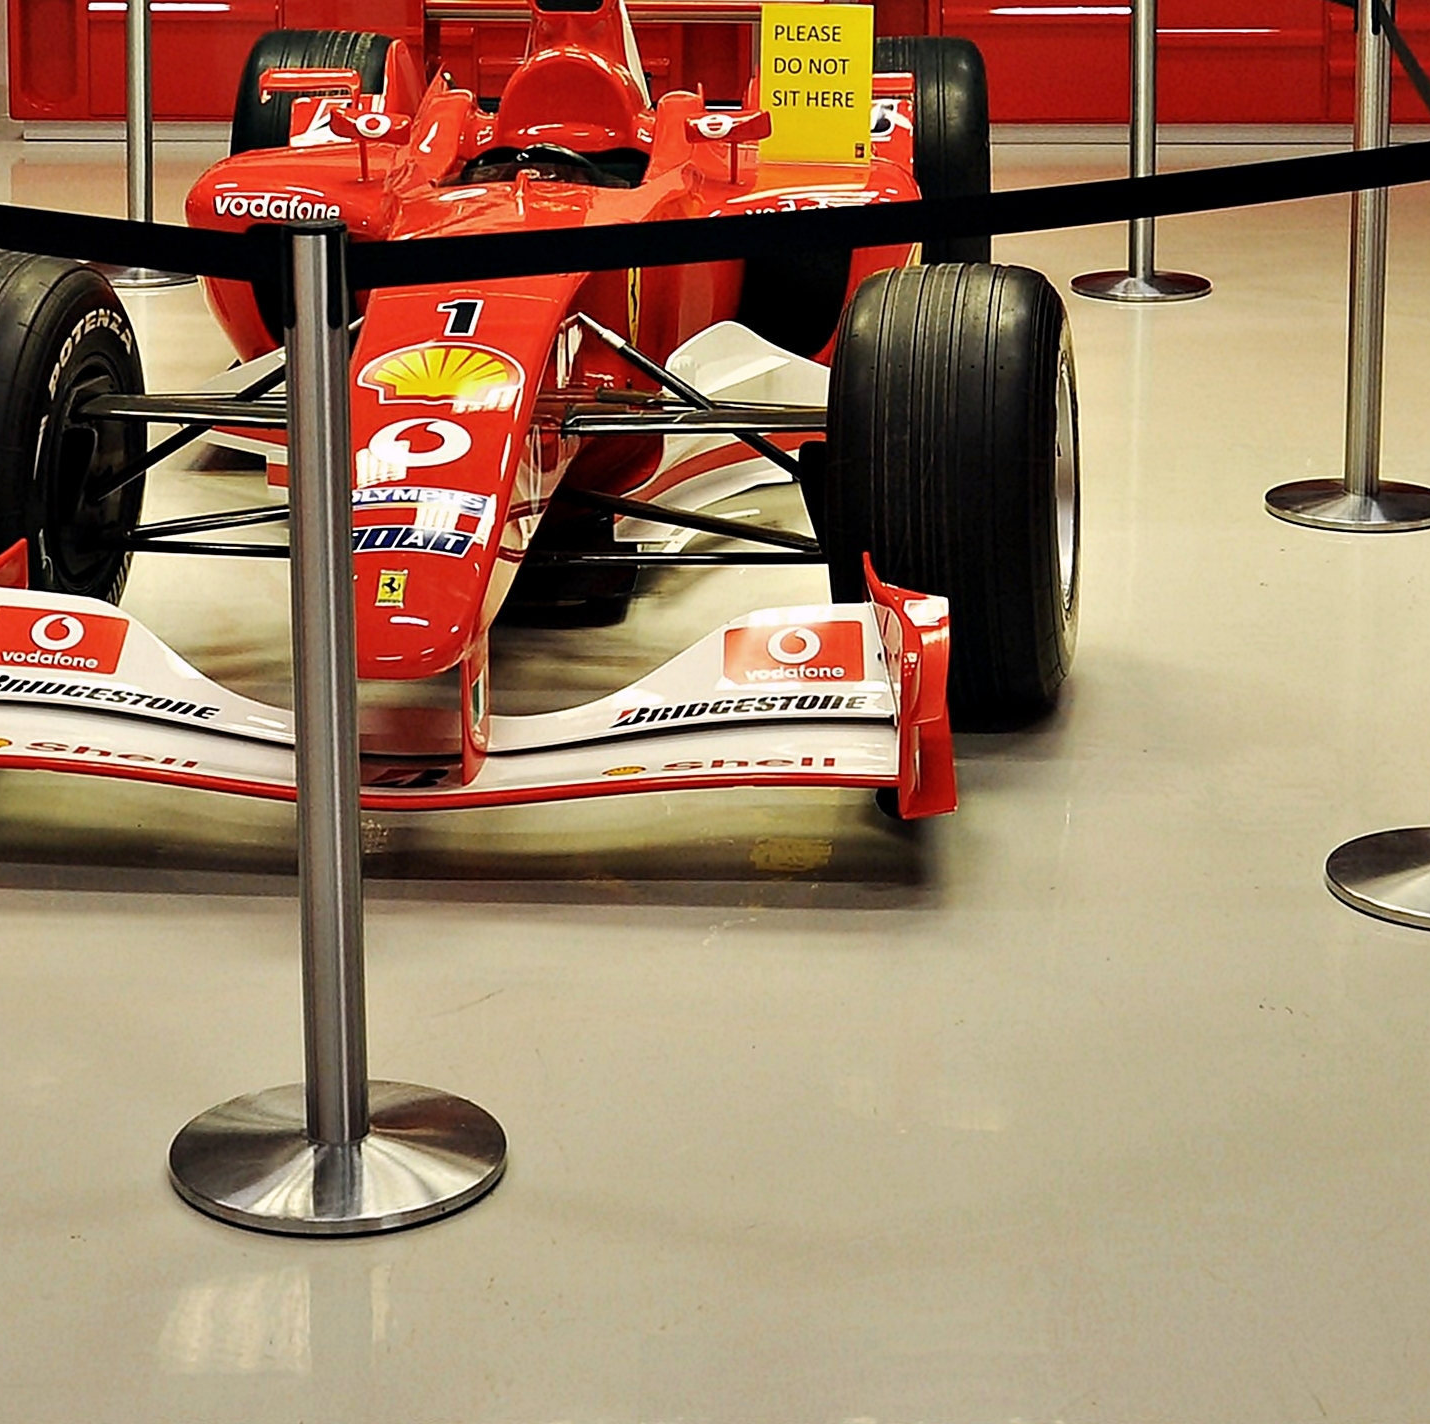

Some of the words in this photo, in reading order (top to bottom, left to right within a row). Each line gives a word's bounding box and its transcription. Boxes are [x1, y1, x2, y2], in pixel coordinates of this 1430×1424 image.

[774, 25, 841, 42] PLEASE
[774, 58, 802, 74] DO
[809, 58, 850, 75] NOT
[772, 90, 800, 107] SIT
[807, 91, 854, 108] HERE
[215, 195, 340, 220] vodafone
[438, 300, 483, 335] 1
[48, 308, 132, 401] POTENZA
[353, 529, 464, 551] IAT
[2, 649, 98, 669] vodafone
[745, 663, 845, 681] vodafone
[608, 694, 867, 728] BRIDGESTONE
[25, 741, 199, 769] Shell
[662, 757, 836, 772] Shell
